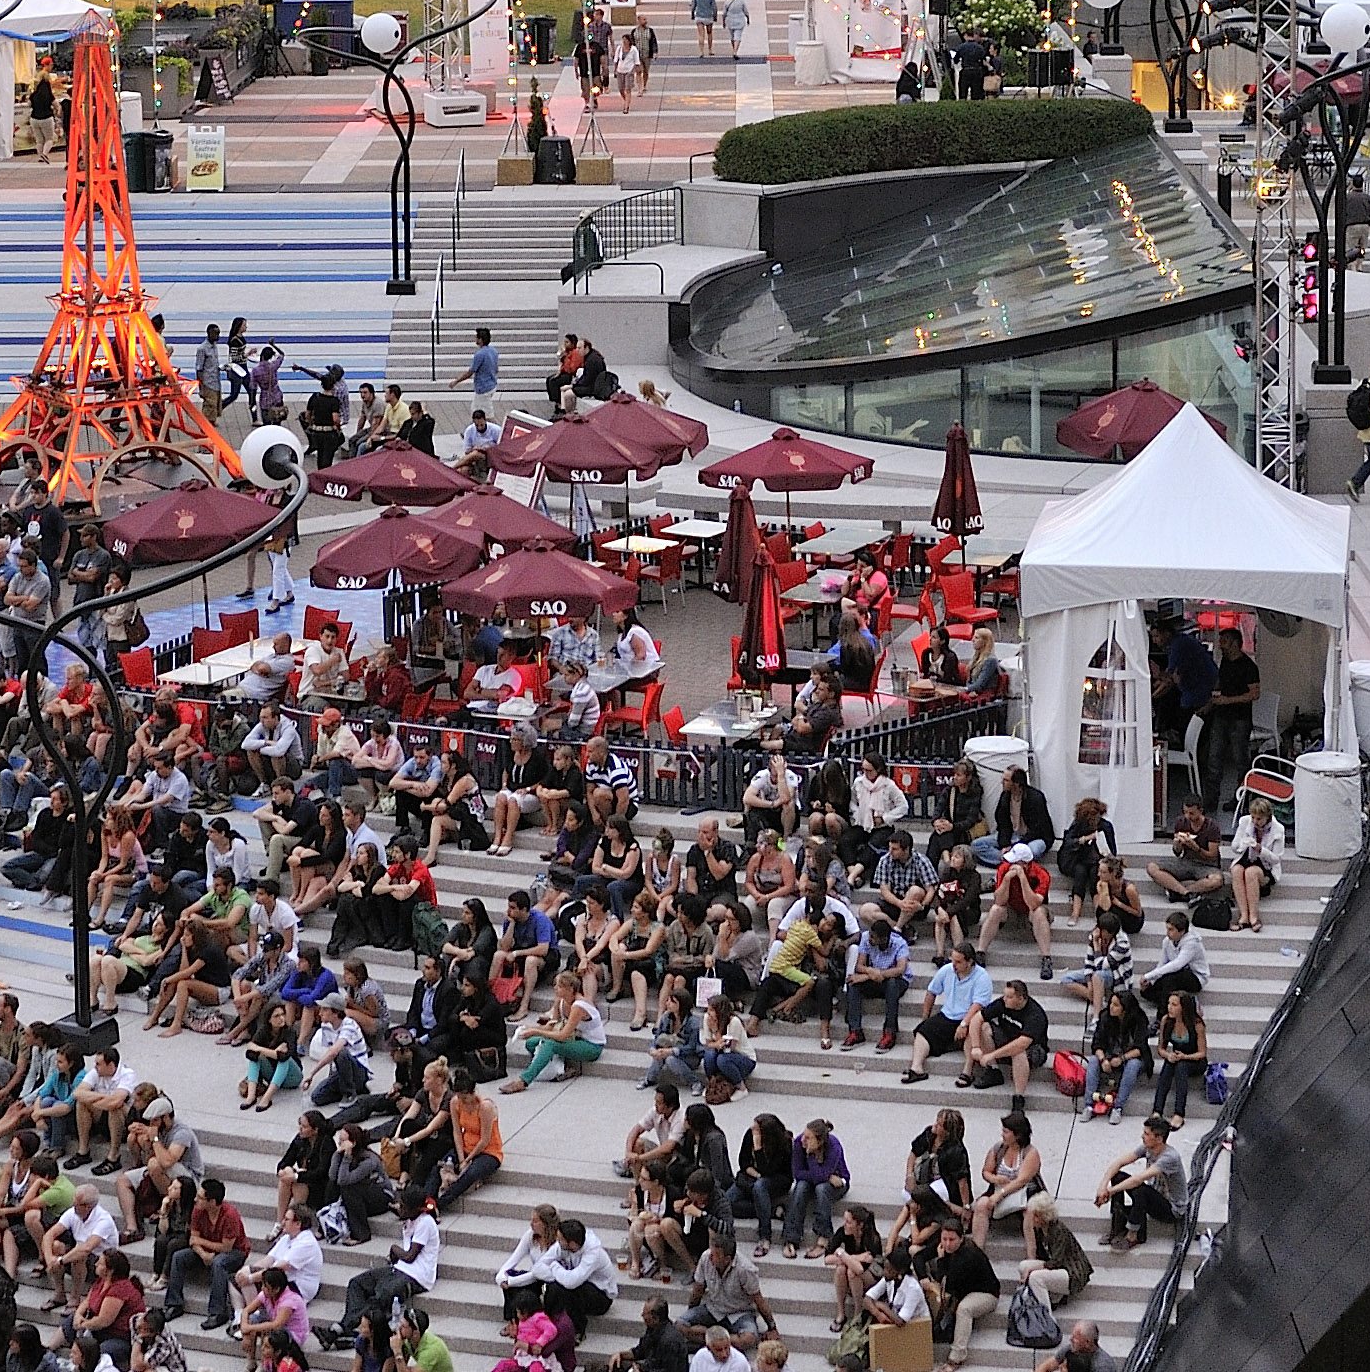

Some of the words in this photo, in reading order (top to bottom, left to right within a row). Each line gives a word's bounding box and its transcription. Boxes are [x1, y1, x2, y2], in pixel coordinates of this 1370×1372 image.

[570, 469, 602, 483] SAQ
[324, 482, 348, 498] SAQ
[336, 575, 367, 589] SAQ
[530, 600, 566, 615] SAQ
[756, 653, 780, 668] SAQ
[409, 735, 429, 744] SAQ
[477, 742, 496, 754] SAQ
